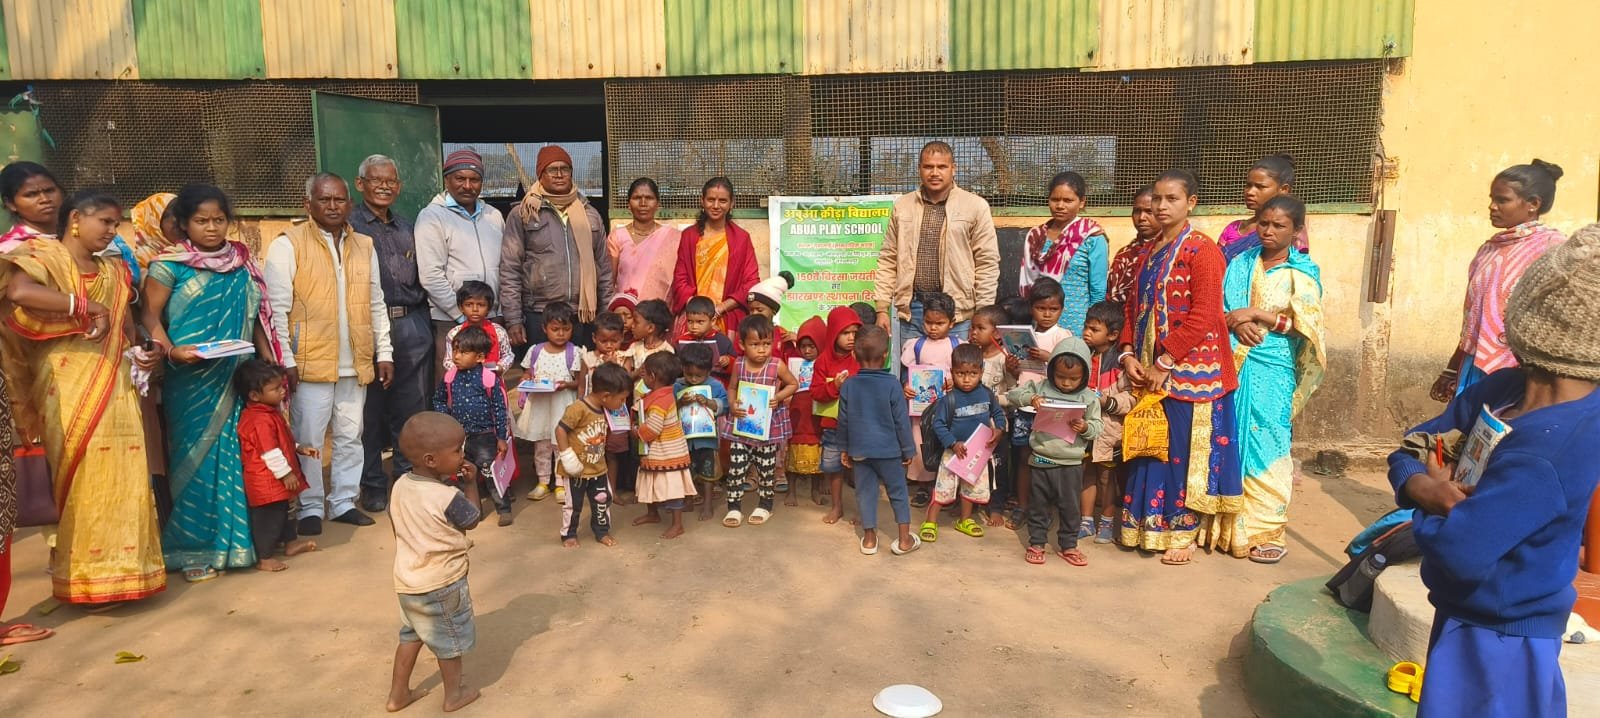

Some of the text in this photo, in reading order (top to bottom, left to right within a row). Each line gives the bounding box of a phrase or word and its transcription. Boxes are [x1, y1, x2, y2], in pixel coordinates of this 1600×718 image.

[790, 223, 883, 235] ABUA PLAY SCHOOL
[597, 504, 607, 525] DAD
